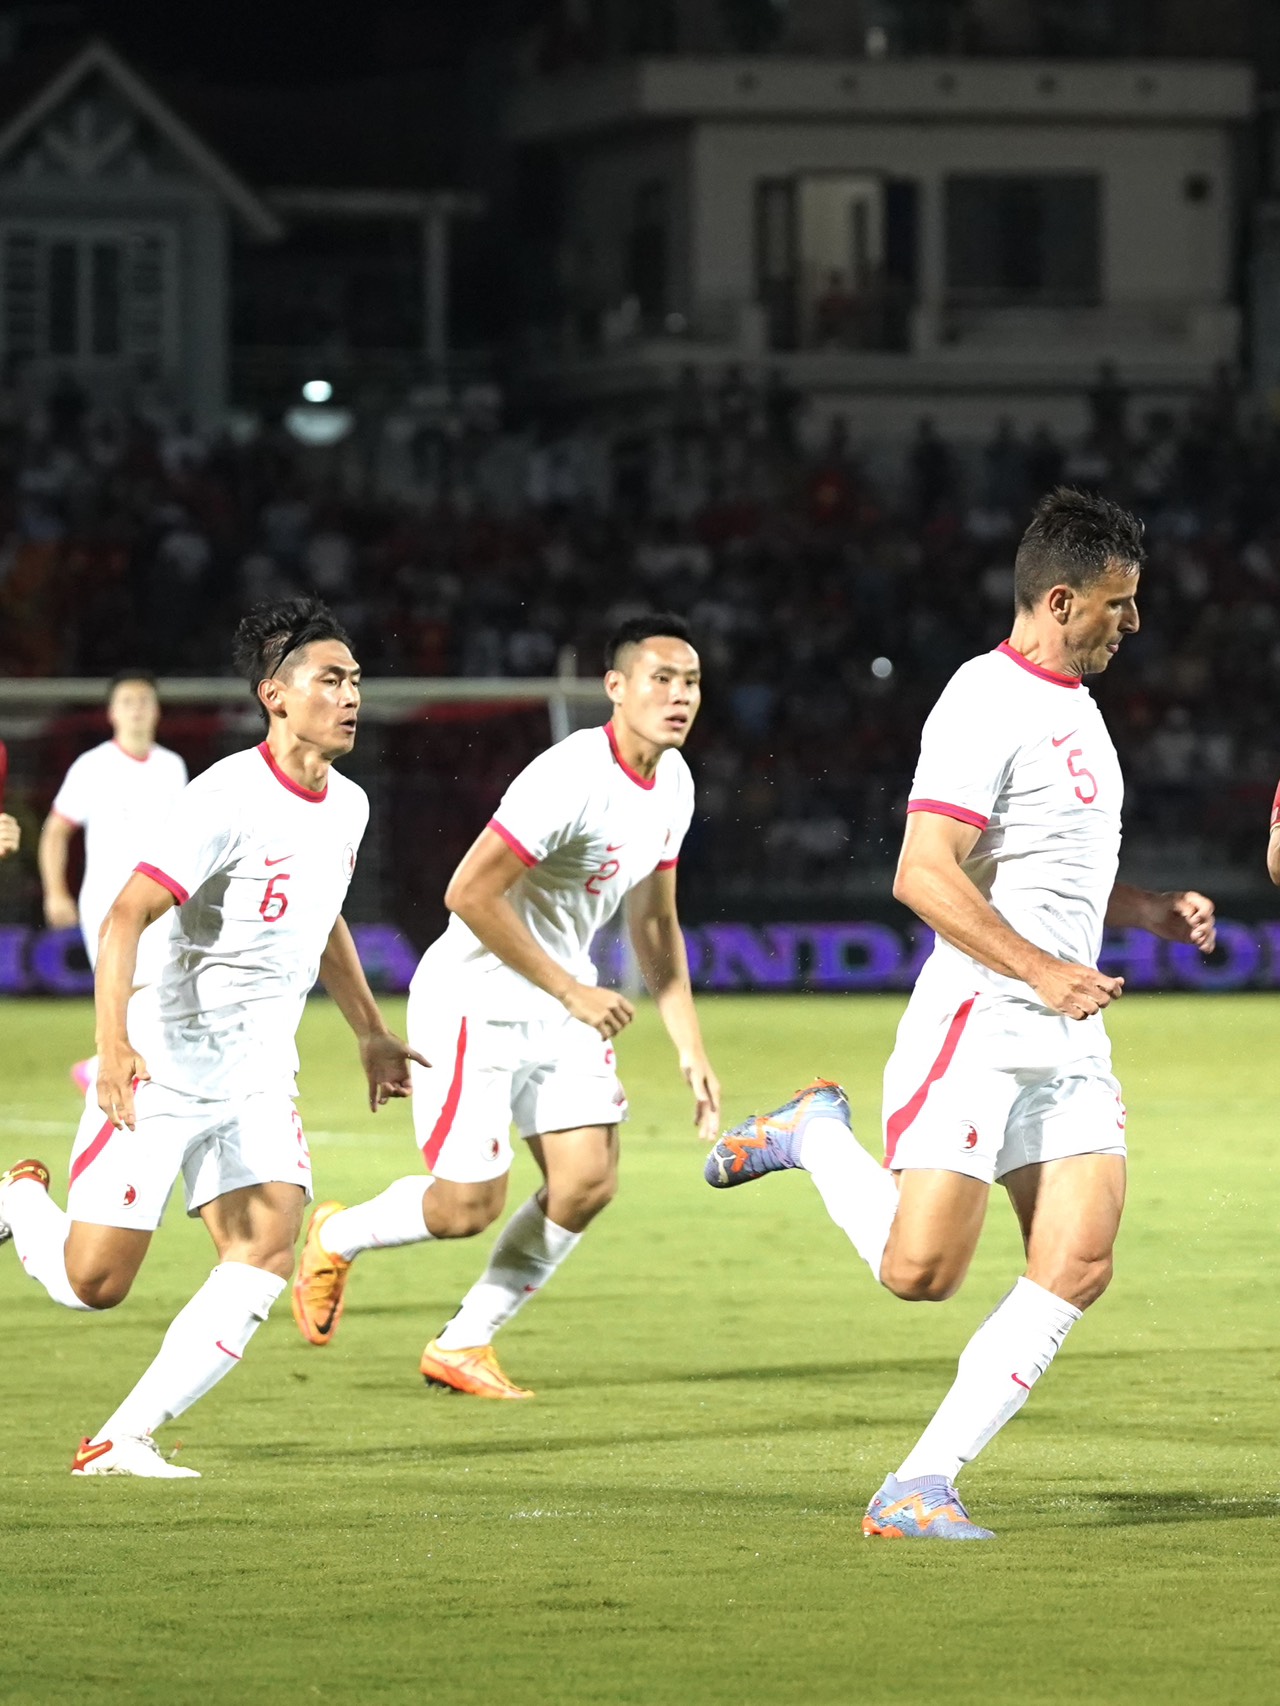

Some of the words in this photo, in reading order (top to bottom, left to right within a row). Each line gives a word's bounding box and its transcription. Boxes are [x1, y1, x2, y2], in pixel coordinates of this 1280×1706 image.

[1067, 749, 1098, 804] 5
[259, 873, 290, 922] 6
[585, 860, 620, 895] 2
